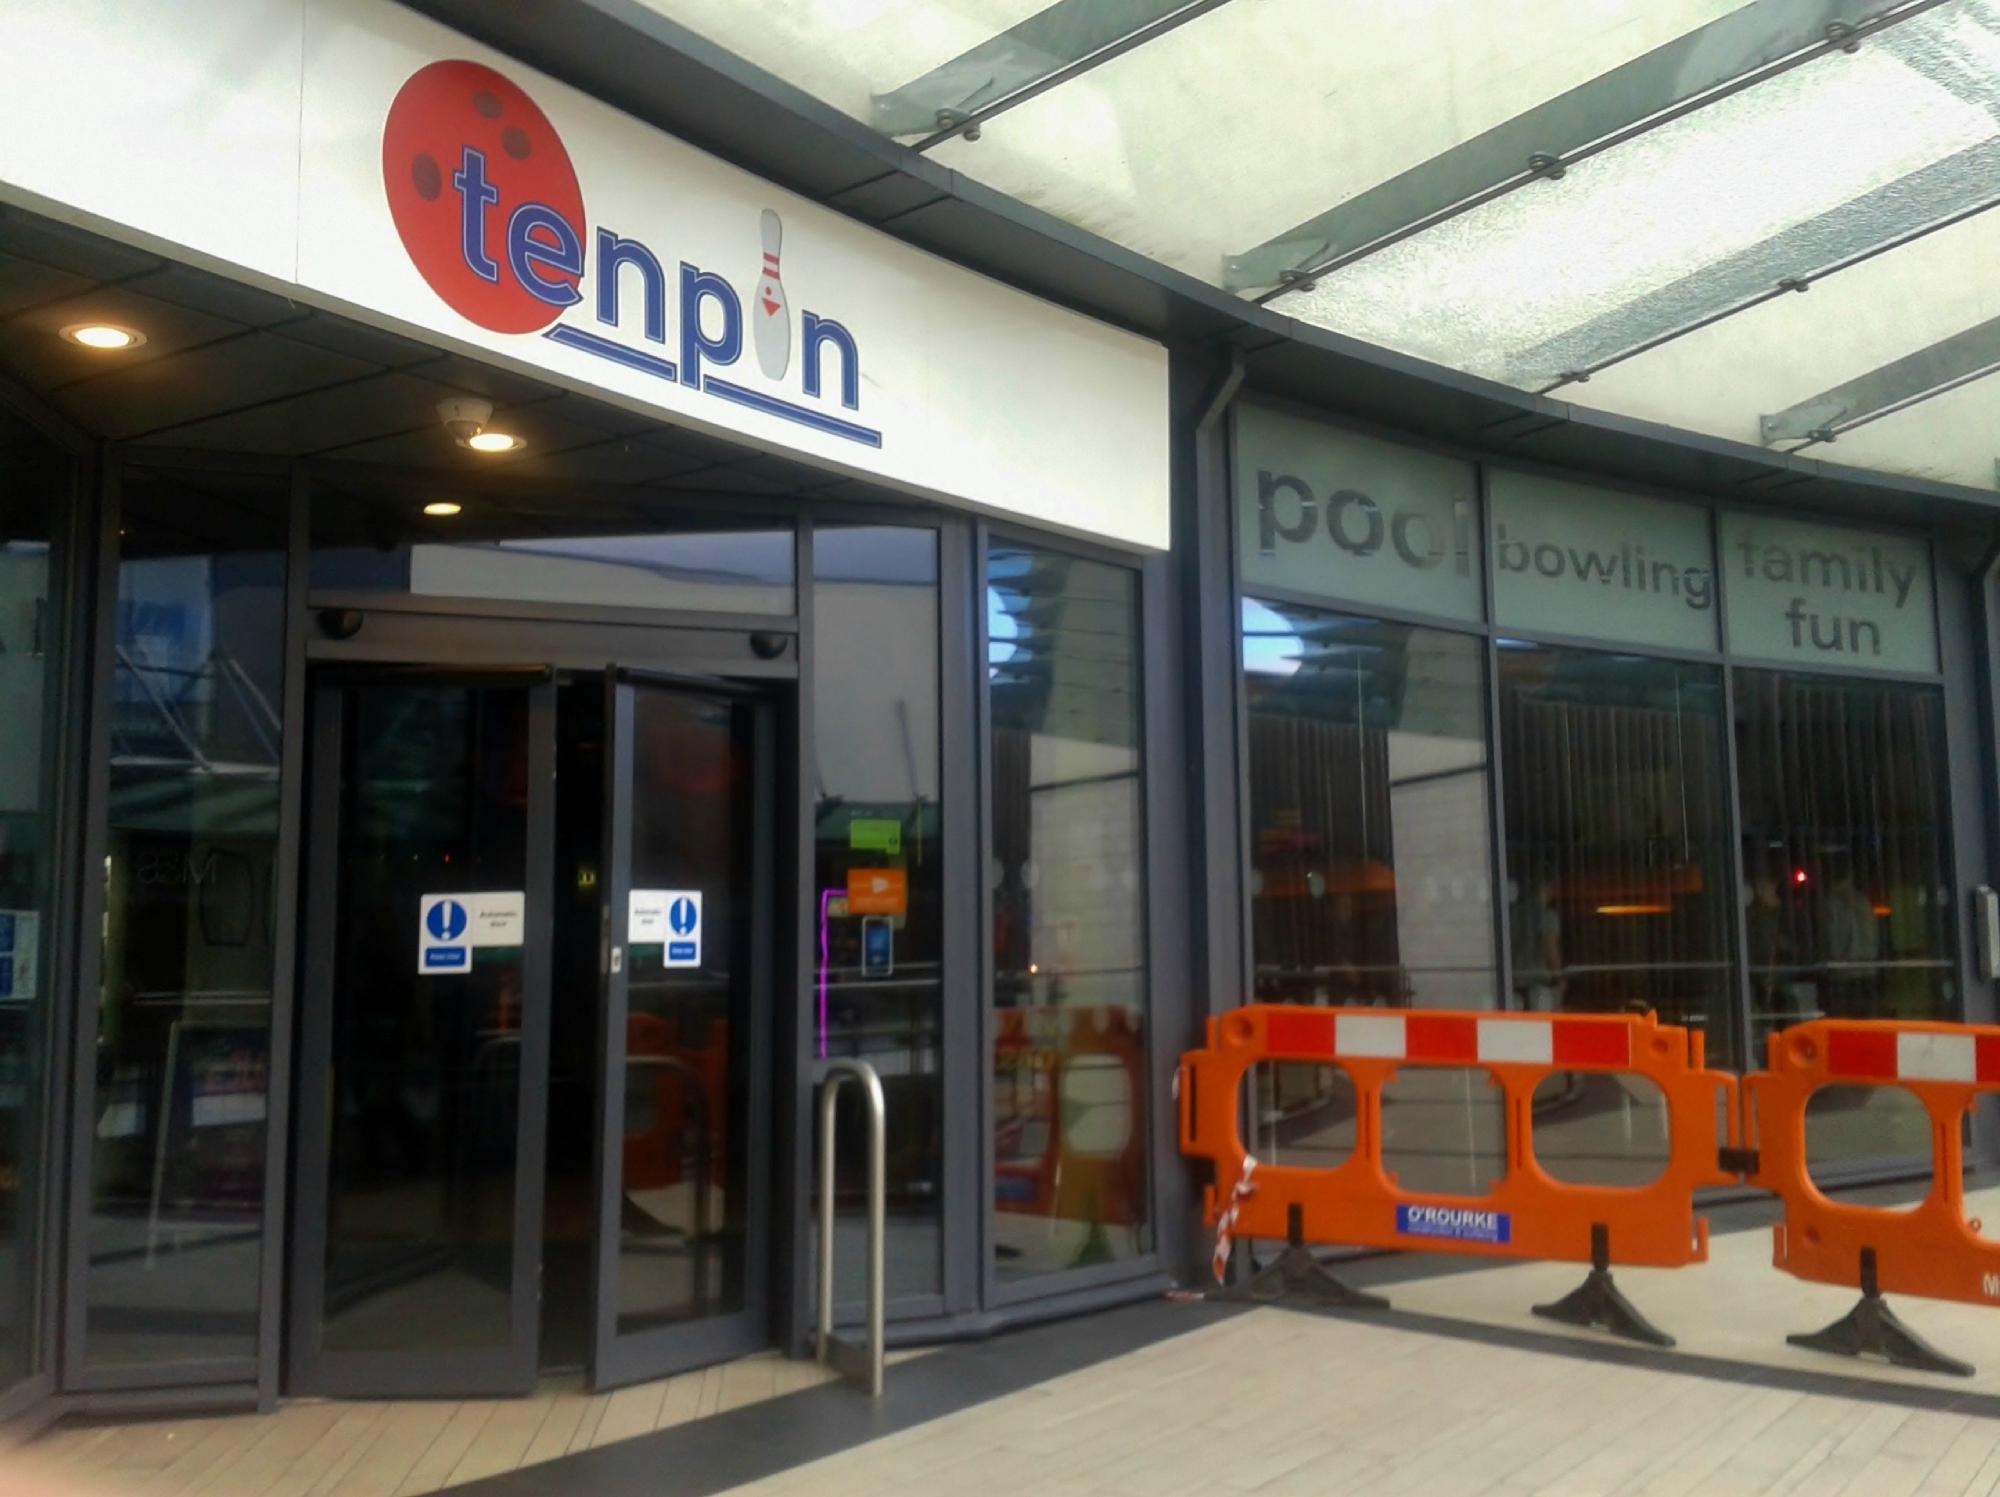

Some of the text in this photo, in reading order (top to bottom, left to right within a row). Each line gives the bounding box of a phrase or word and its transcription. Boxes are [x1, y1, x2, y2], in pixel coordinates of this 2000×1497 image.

[452, 144, 860, 412] tenpin
[1256, 468, 1470, 577] pool
[1498, 522, 1713, 611] bowling
[1737, 532, 1917, 609] family
[1785, 596, 1881, 655] fun
[1408, 1205, 1498, 1231] O'ROURKE
